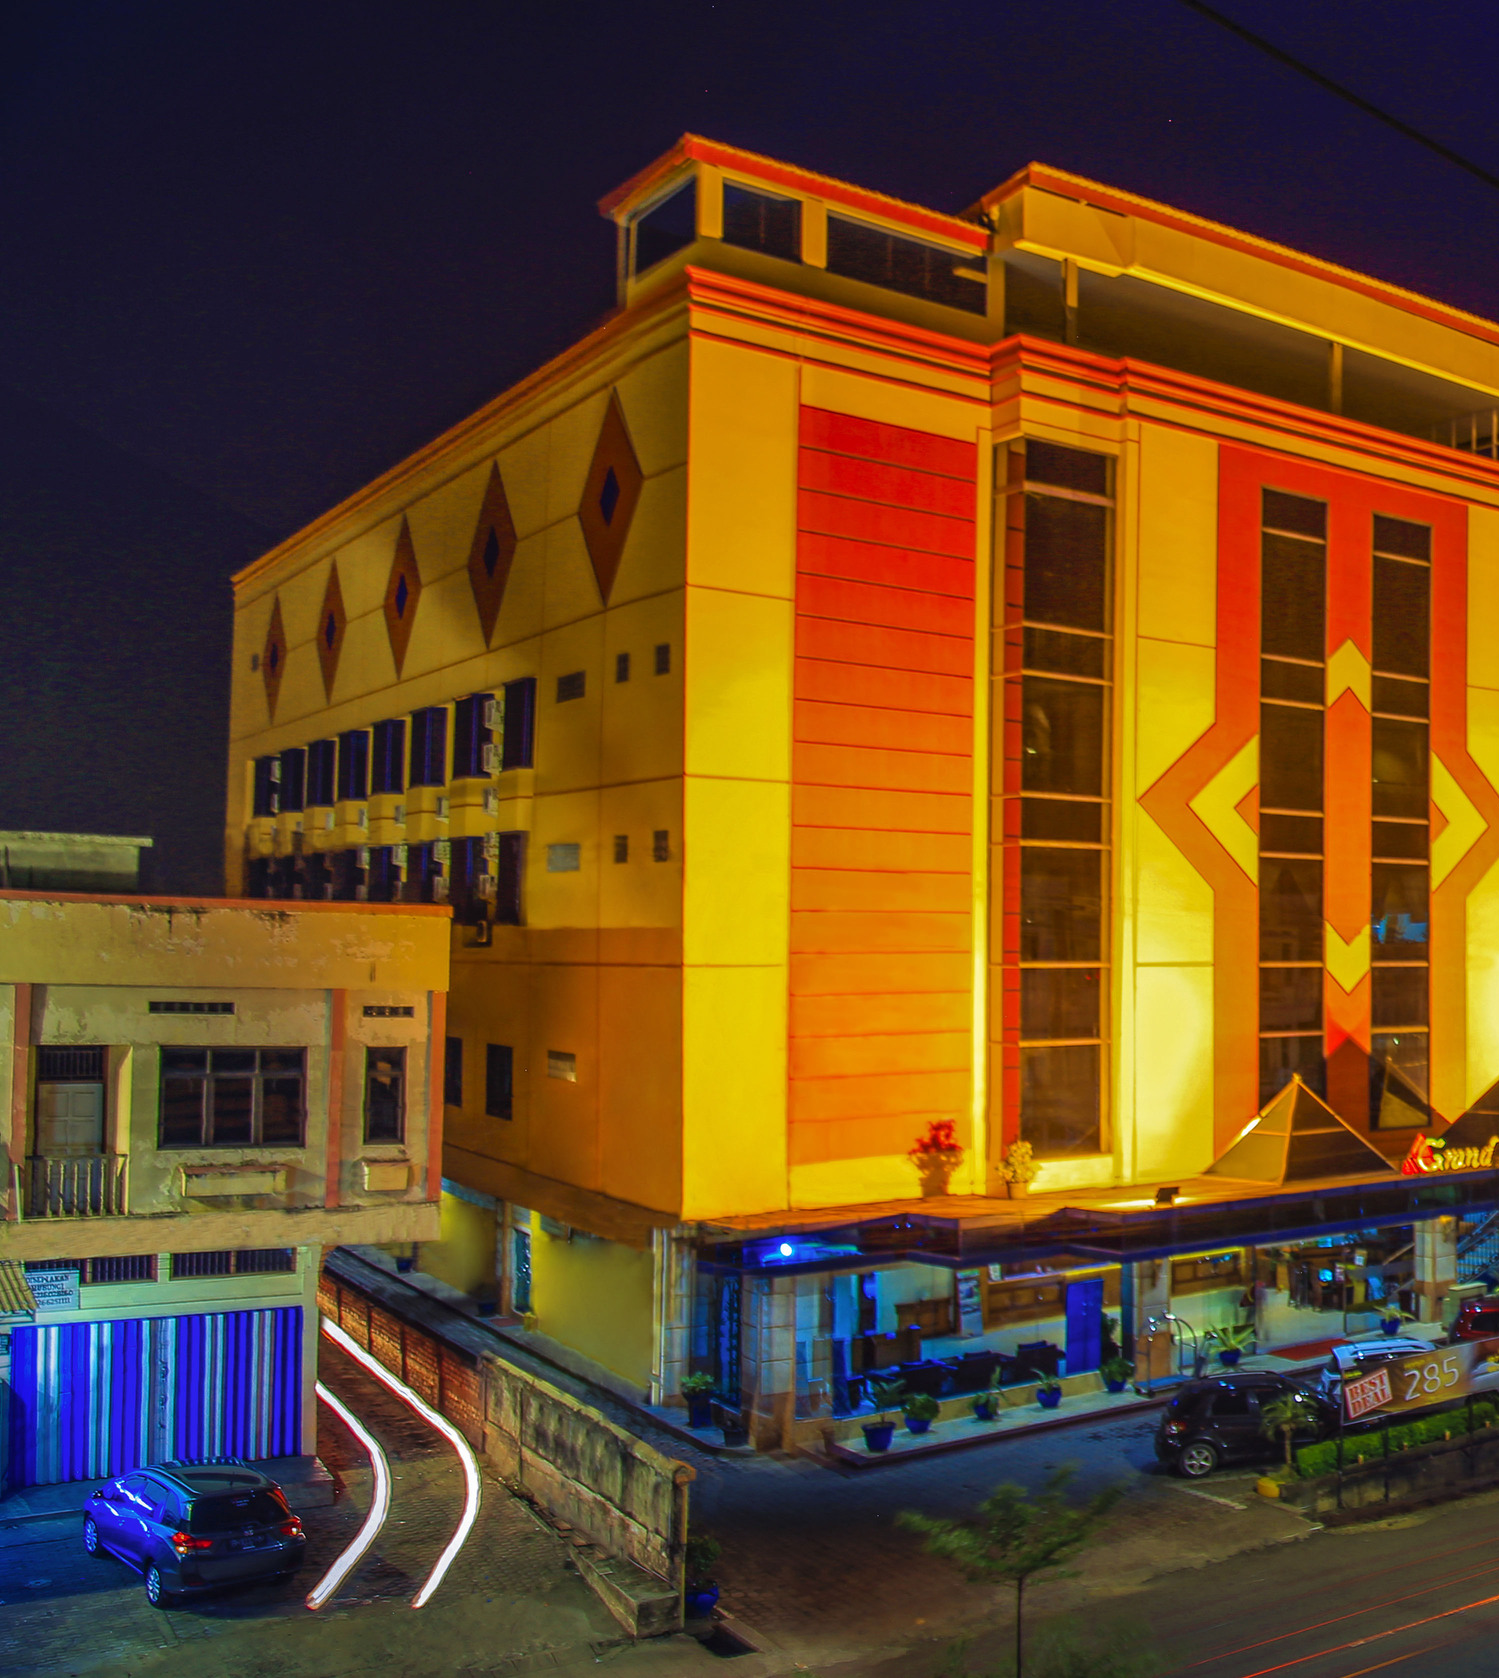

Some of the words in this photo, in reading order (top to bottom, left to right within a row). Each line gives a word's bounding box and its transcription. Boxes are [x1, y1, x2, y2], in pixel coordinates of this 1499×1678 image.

[1350, 1370, 1386, 1397] BEST
[1403, 1356, 1460, 1401] 285
[1351, 1387, 1391, 1415] DEAL
